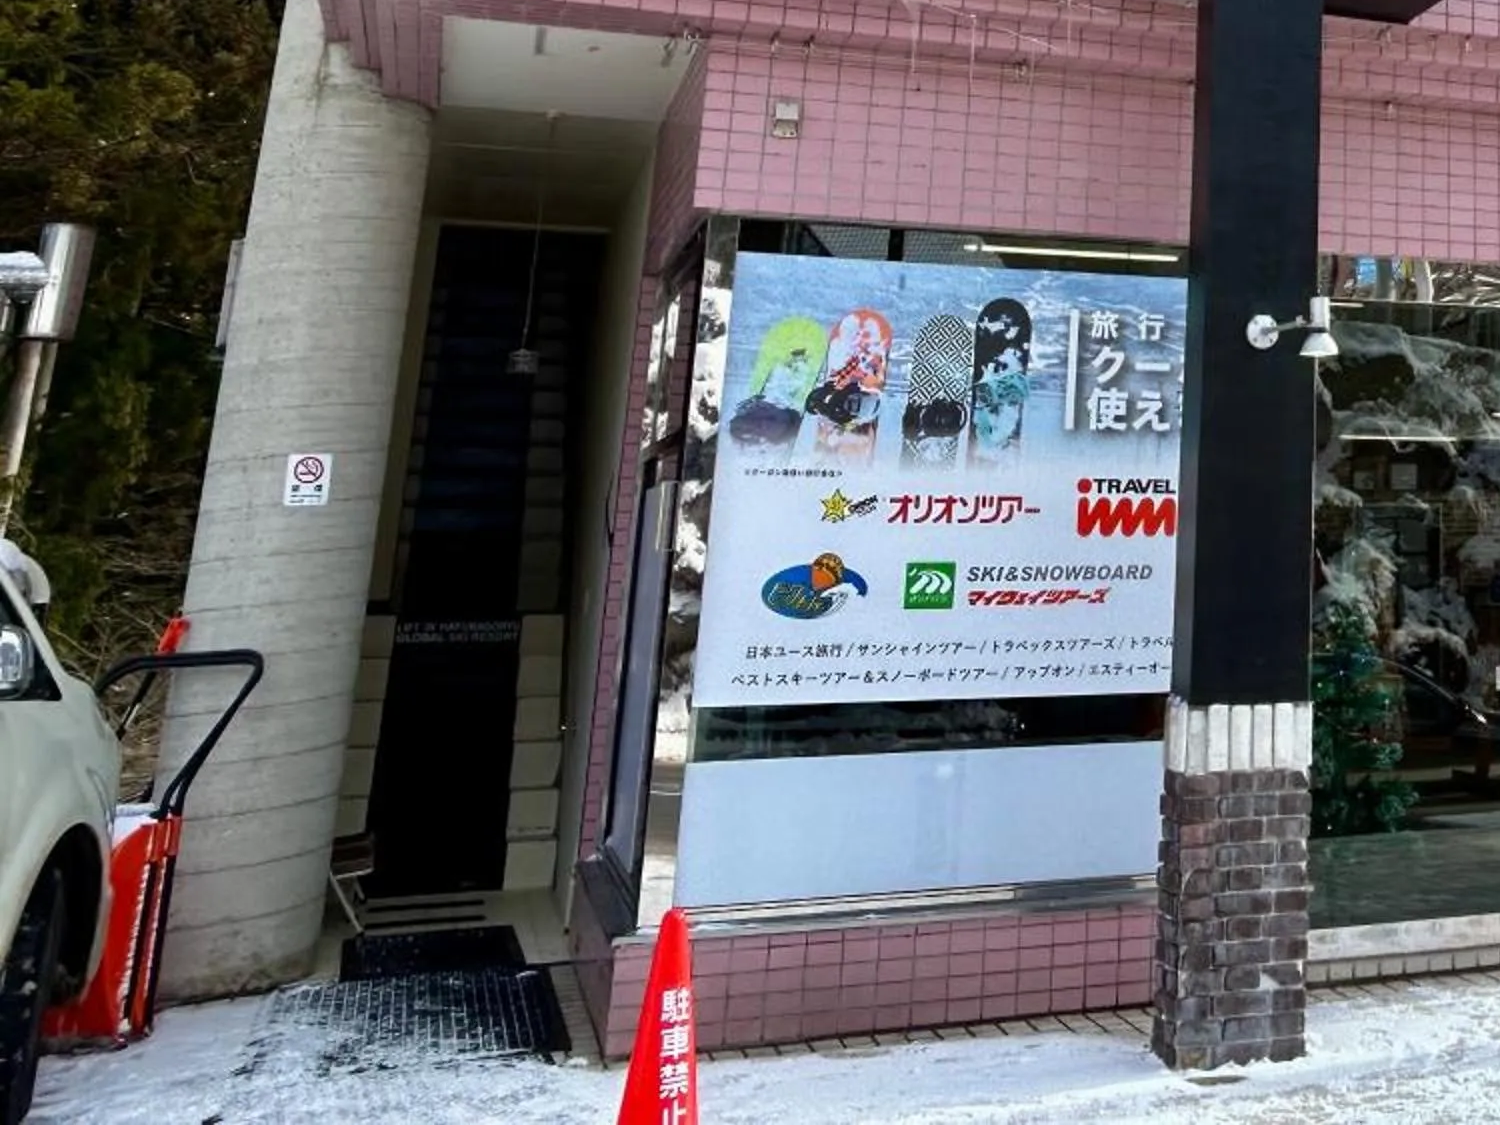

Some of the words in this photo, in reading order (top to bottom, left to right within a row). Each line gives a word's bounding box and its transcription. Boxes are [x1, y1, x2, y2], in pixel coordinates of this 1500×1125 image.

[1092, 345, 1183, 384] クー
[1087, 386, 1182, 432] 使え
[1094, 478, 1176, 494] TRAVEL
[967, 565, 1153, 582] SKI&SNOWBOARD
